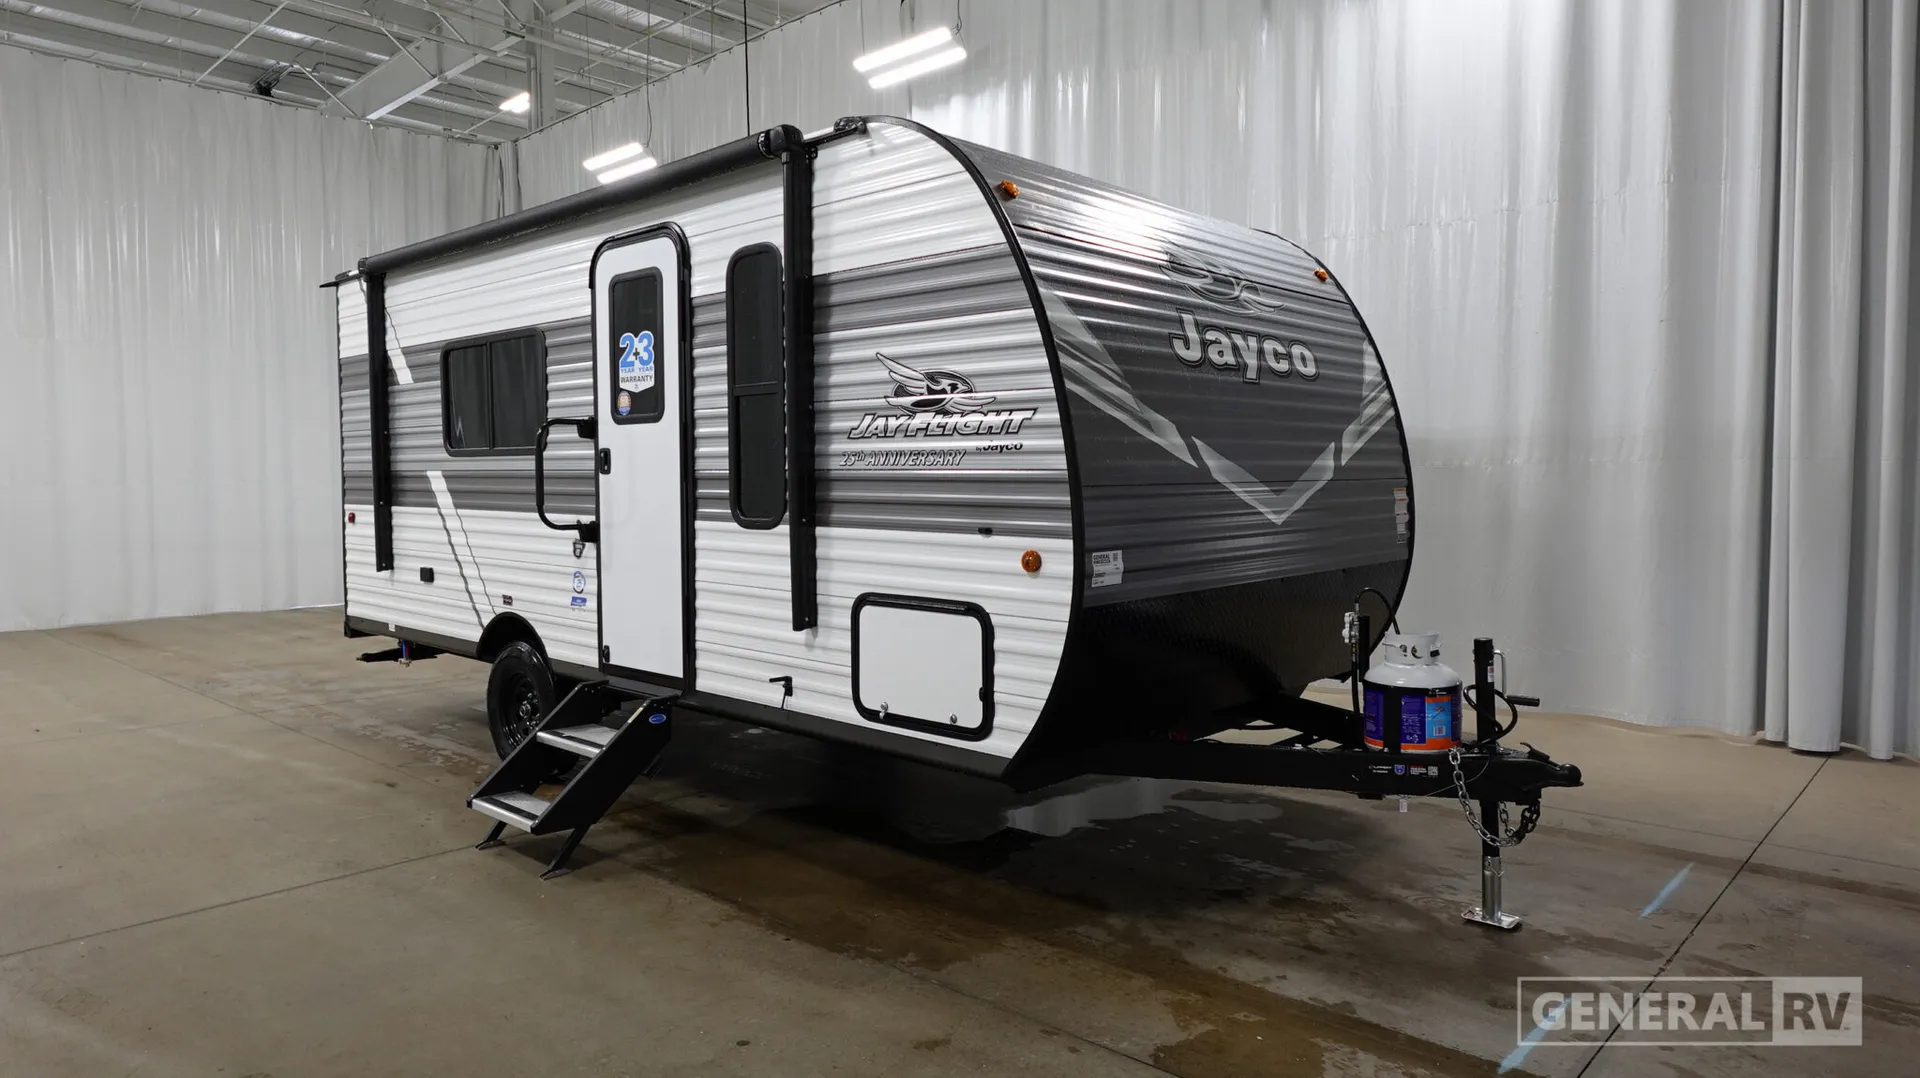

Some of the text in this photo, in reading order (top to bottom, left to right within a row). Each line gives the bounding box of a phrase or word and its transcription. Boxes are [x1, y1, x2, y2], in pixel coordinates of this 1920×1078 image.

[1168, 308, 1320, 384] Jayco
[620, 375, 653, 384] WARRANTY
[848, 407, 1039, 439] JAY FLIGHT
[983, 441, 1023, 453] Jayco
[839, 449, 966, 466] 25th ANNIVERSARY
